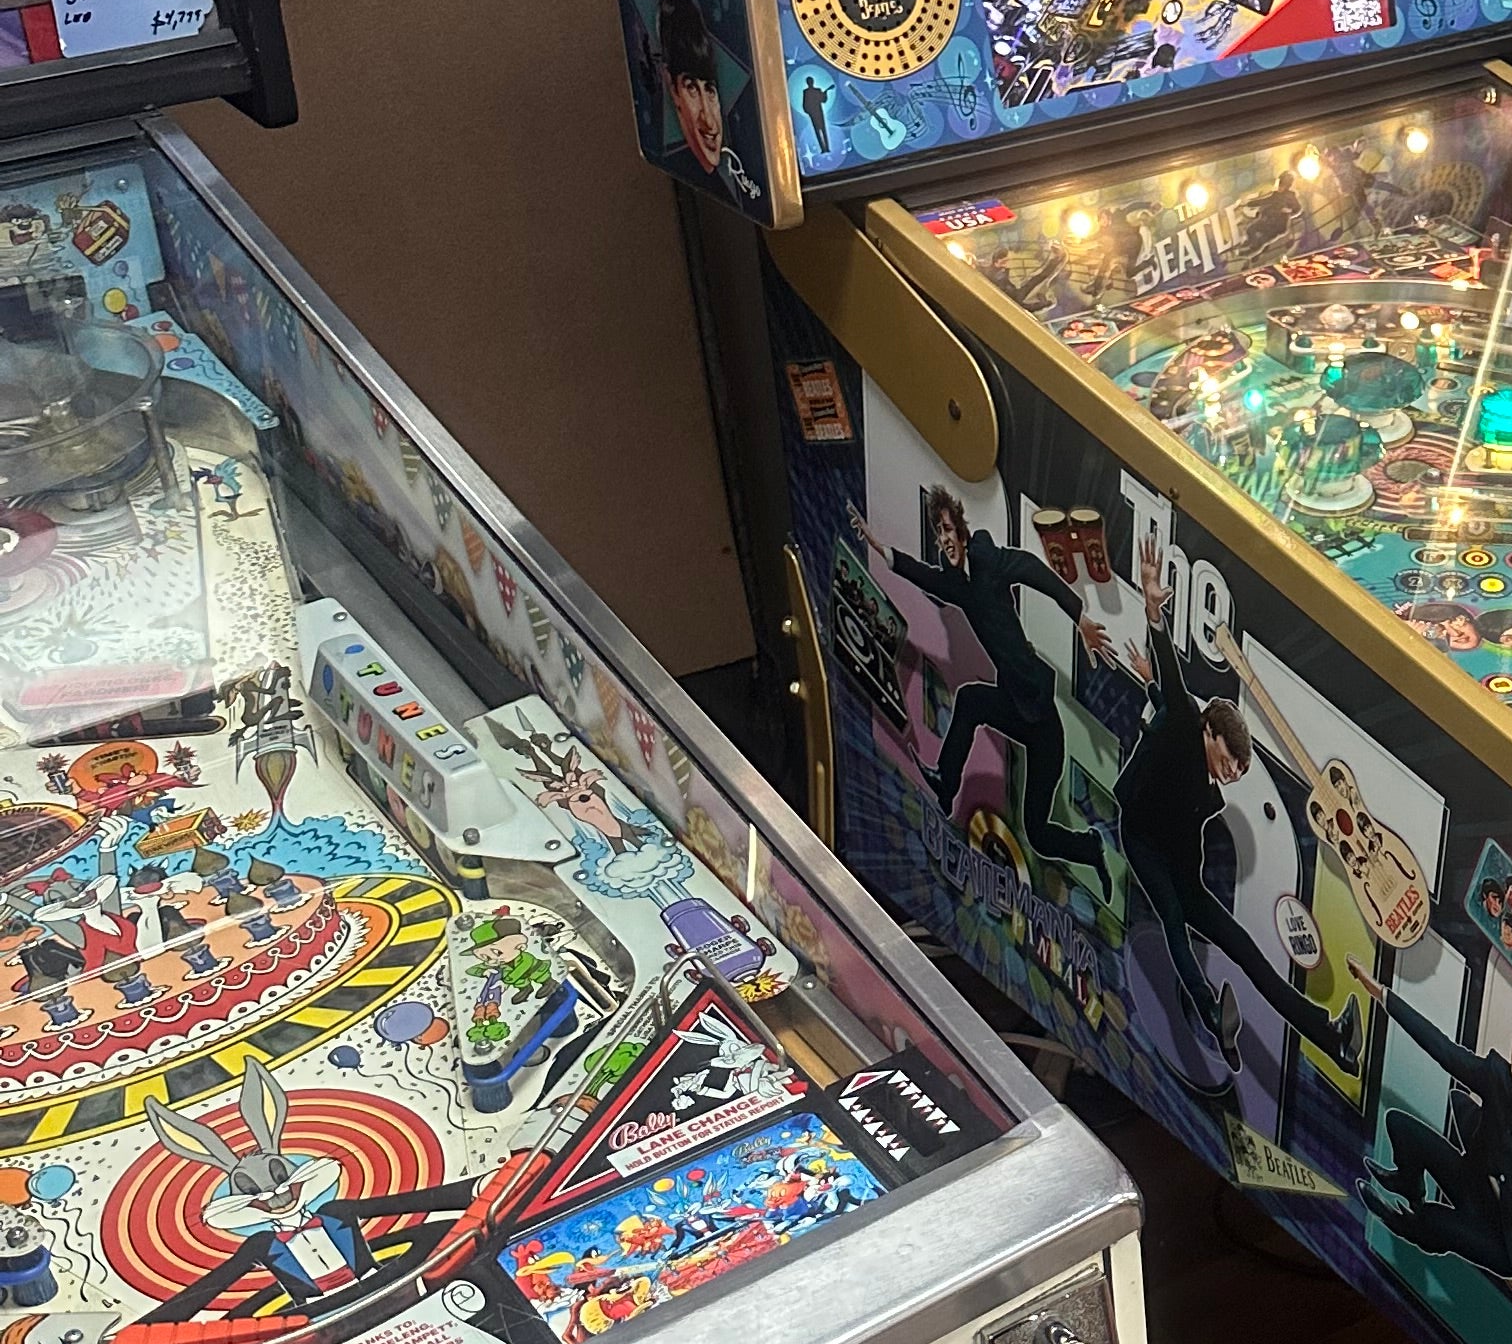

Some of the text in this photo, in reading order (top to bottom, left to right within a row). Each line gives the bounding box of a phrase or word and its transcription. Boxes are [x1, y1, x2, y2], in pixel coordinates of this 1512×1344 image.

[945, 213, 995, 233] USA
[1286, 915, 1308, 933] LOVE
[1383, 884, 1422, 935] BEATLES
[1288, 934, 1318, 957] RINGO
[608, 1112, 681, 1151] Bally
[624, 1095, 786, 1171] HOLD BUTTON FOR STATUS REPORT
[637, 1095, 763, 1155] LANE CHANGE
[1263, 1144, 1317, 1191] BEATLES
